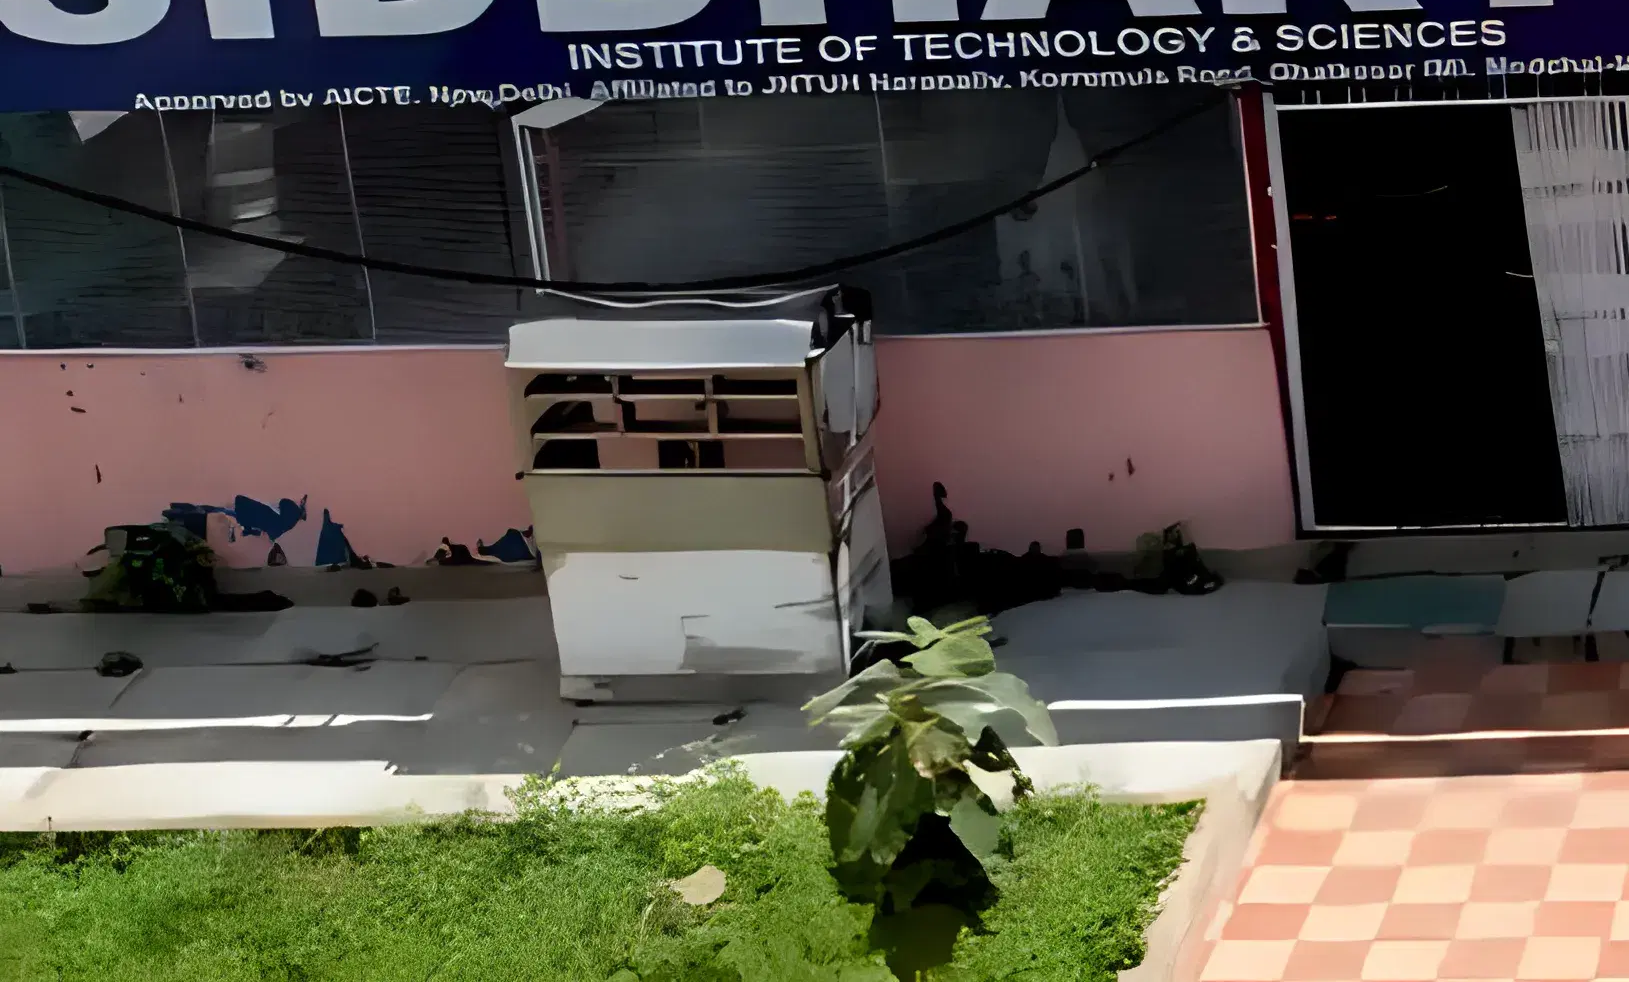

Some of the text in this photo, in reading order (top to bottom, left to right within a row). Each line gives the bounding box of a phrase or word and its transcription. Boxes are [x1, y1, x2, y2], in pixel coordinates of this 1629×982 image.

[566, 19, 1508, 70] INSTITUTE OF TECHNOLOGY & SCIENCES
